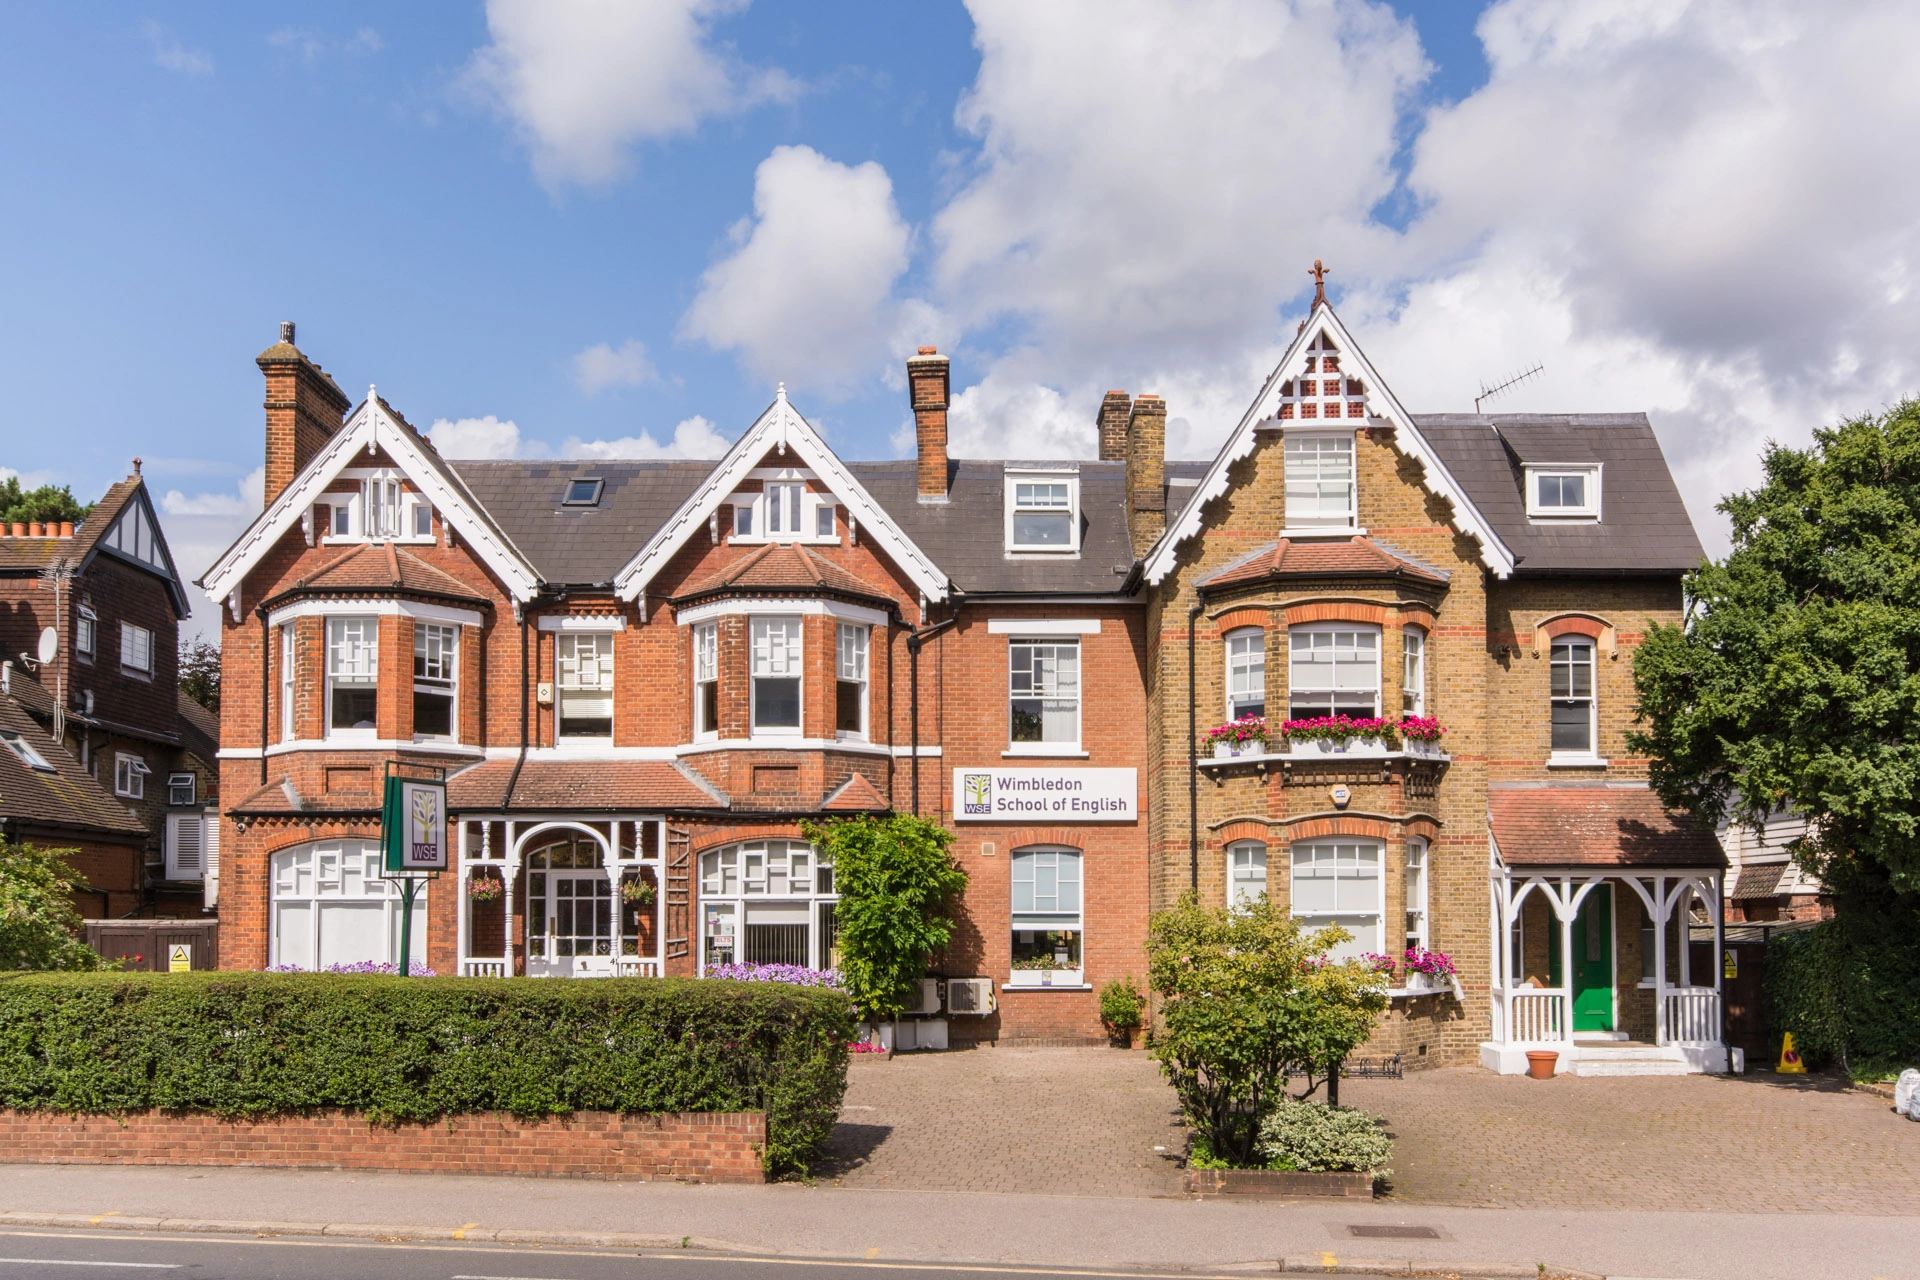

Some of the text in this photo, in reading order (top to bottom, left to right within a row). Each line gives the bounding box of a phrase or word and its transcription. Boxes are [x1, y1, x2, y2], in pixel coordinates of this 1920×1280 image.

[997, 777, 1082, 790] Wimbledon
[966, 804, 990, 812] WSE
[997, 798, 1127, 814] School of English
[413, 845, 436, 859] WSE
